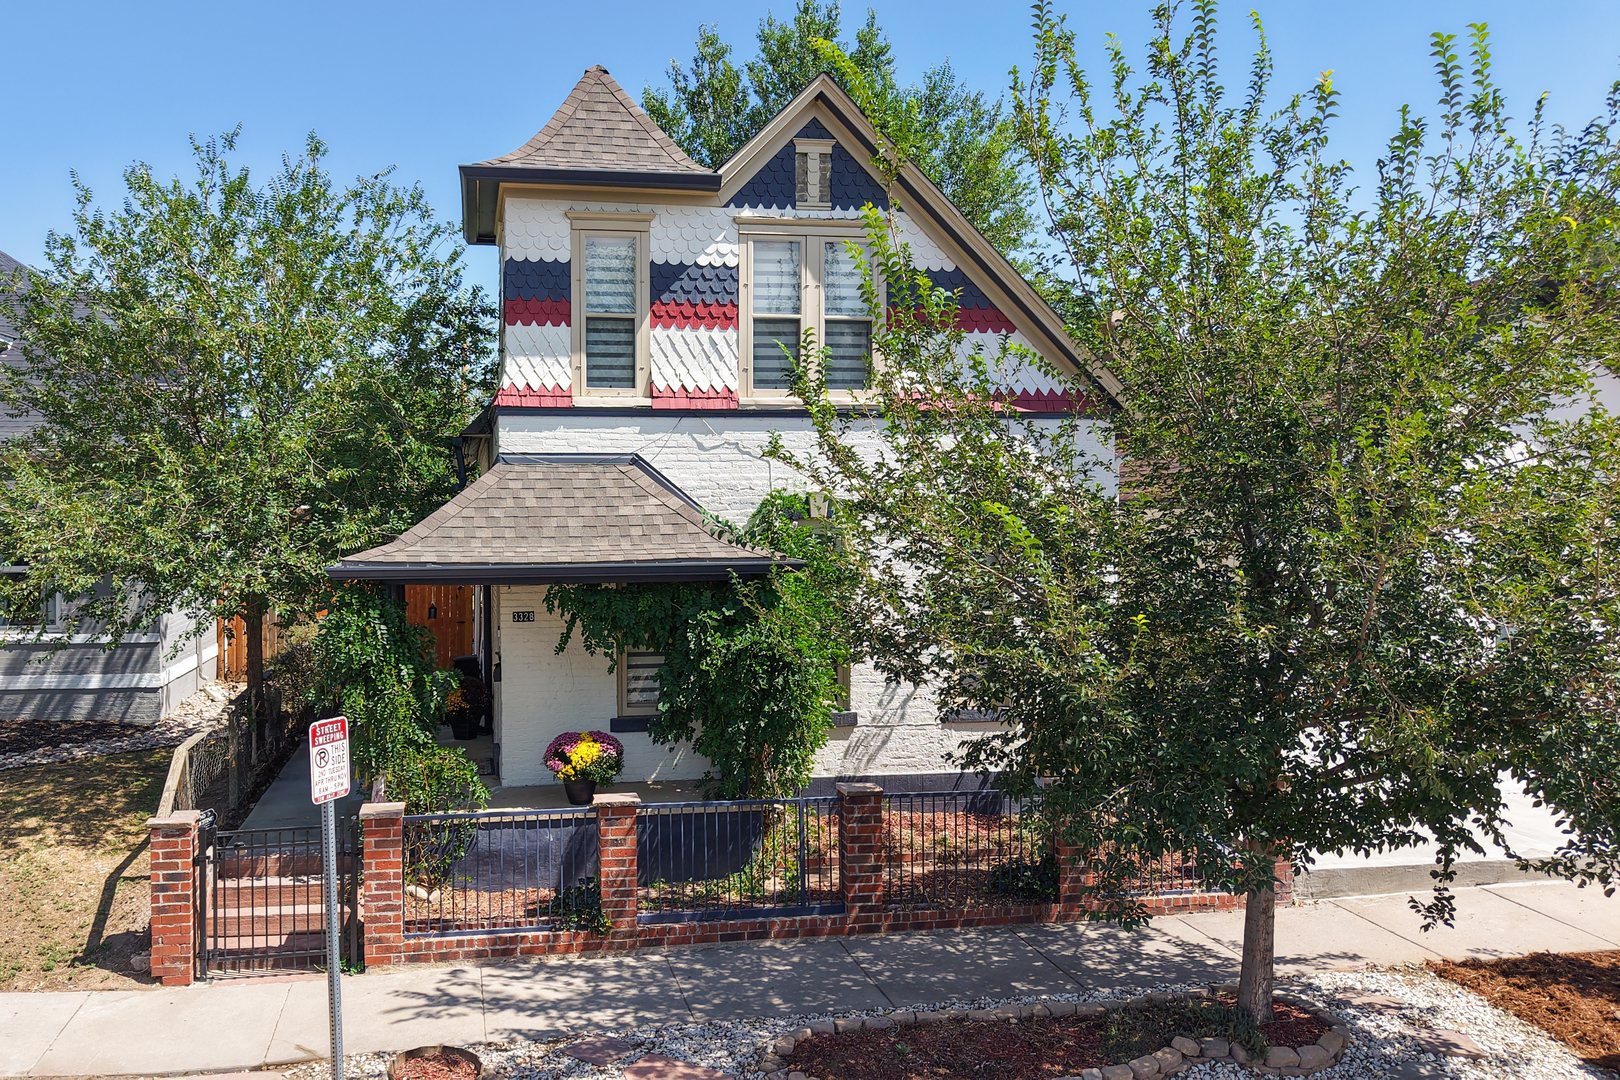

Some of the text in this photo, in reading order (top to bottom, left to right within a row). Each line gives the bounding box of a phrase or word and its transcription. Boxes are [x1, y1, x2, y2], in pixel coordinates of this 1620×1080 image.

[513, 612, 534, 621] 3328
[316, 722, 341, 736] STREET
[314, 731, 344, 746] SWEEPING
[331, 742, 345, 754] THIS
[331, 753, 346, 766] SIDE
[318, 765, 346, 778] 2ND TUESDAY
[325, 775, 337, 784] THRU
[338, 772, 347, 780] NOV
[318, 786, 328, 794] 8AM
